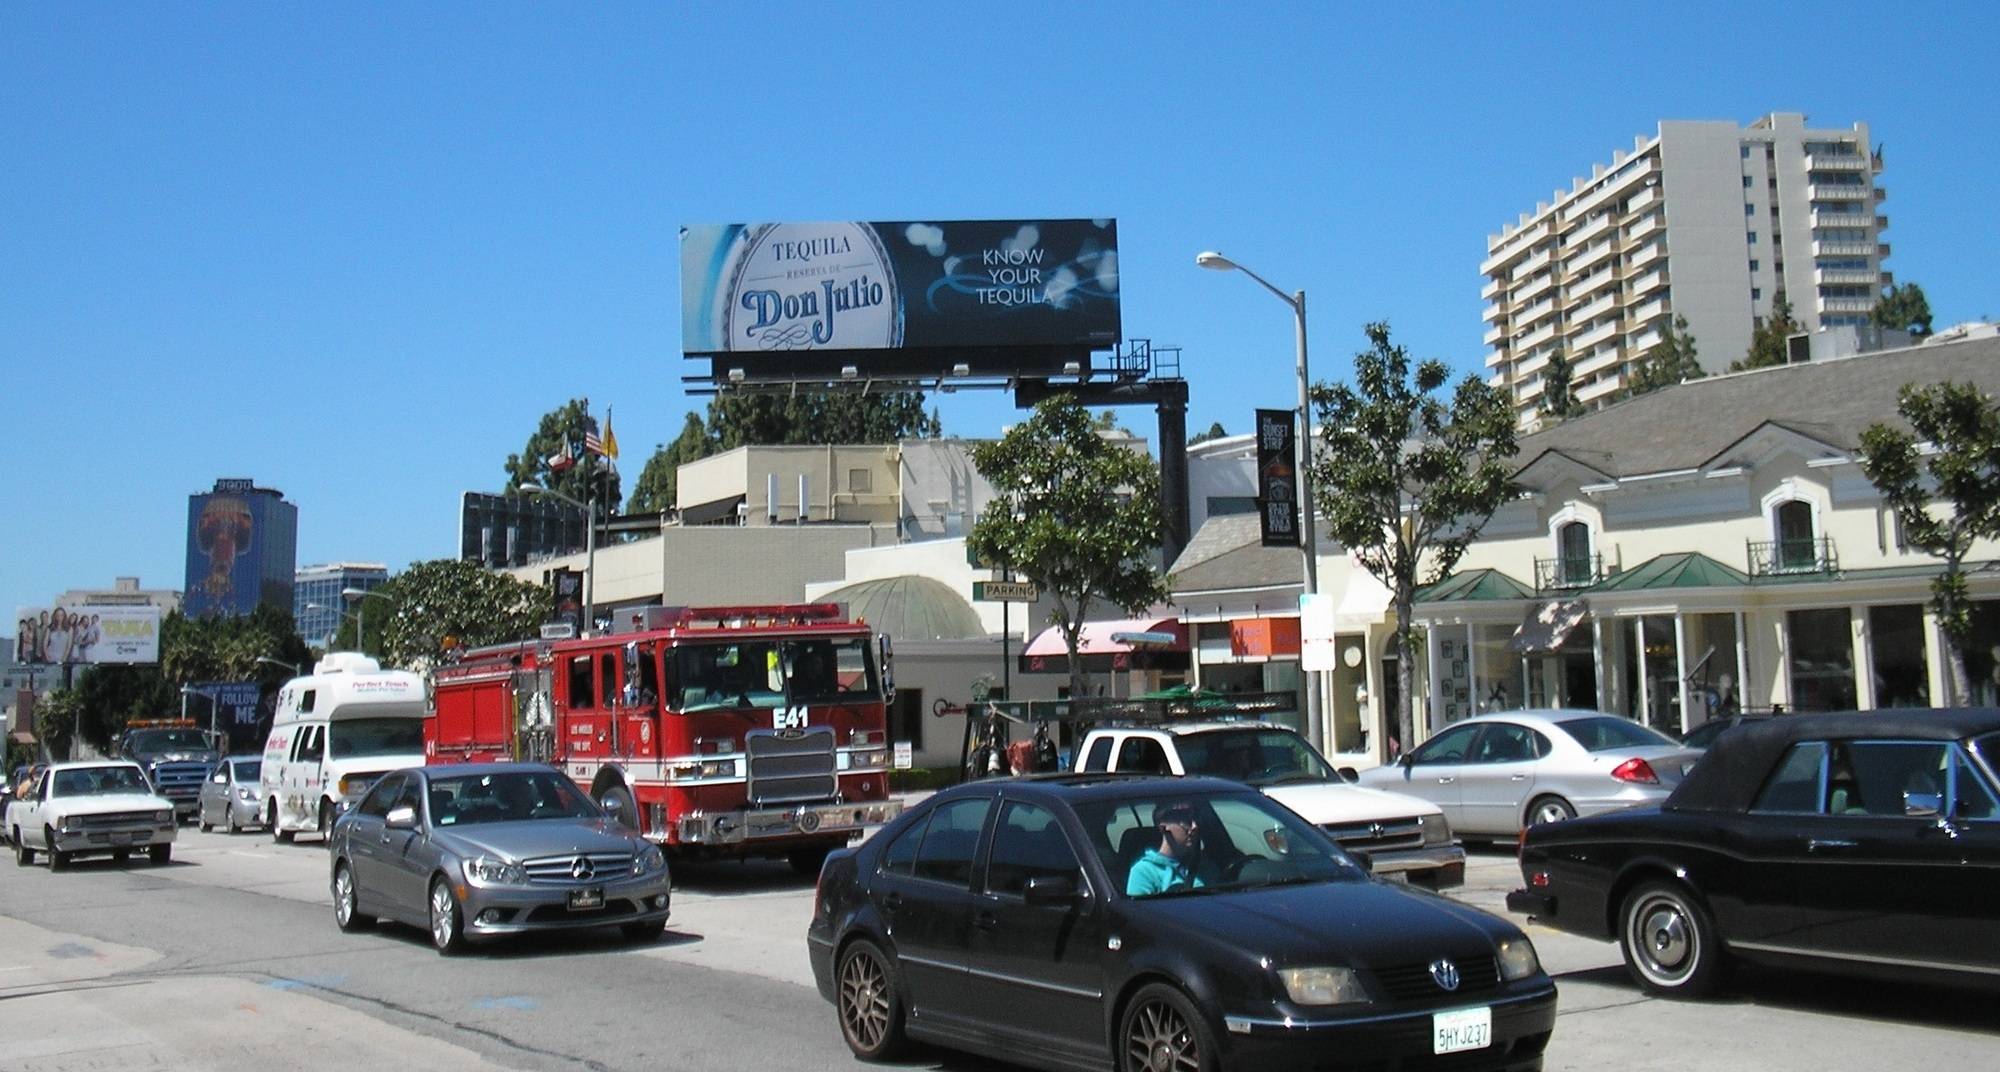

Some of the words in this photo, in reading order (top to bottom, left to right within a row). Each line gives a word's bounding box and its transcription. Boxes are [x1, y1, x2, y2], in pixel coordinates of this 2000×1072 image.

[772, 235, 851, 262] TEQUILA
[982, 248, 1045, 266] KNOW
[786, 266, 828, 280] RESERVA
[829, 265, 841, 275] DE
[988, 268, 1042, 285] YOUR
[975, 287, 1055, 307] TEQUILA
[741, 289, 820, 338] Don
[811, 274, 884, 345] Julio
[1262, 424, 1288, 439] SUNSET
[1263, 438, 1283, 450] STRIP
[986, 584, 1034, 597] PARKING
[222, 693, 260, 705] FOLLOW
[235, 705, 256, 725] ME
[772, 705, 809, 729] E41
[1439, 1023, 1488, 1048] 5HYJ237
